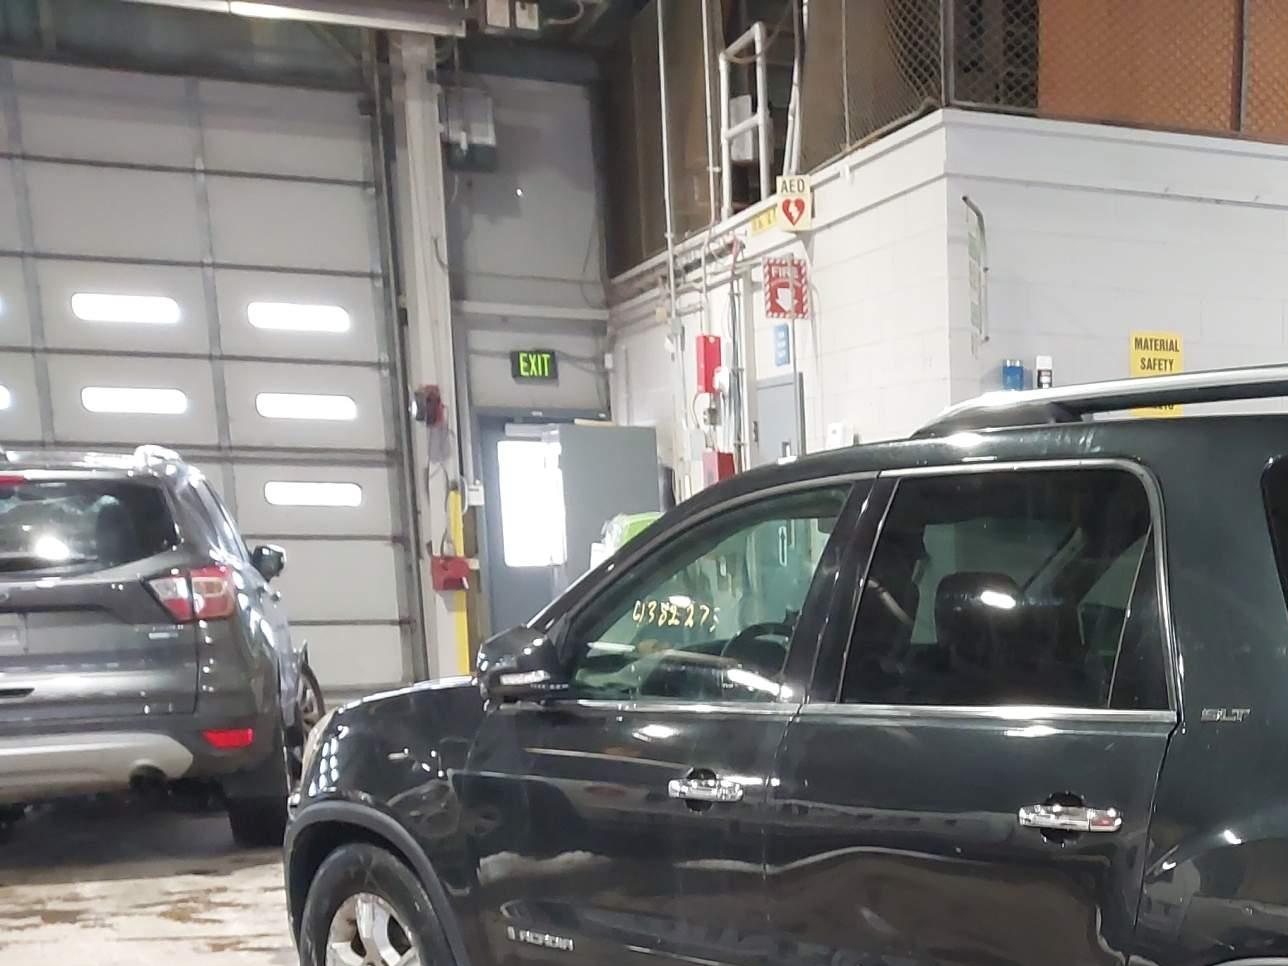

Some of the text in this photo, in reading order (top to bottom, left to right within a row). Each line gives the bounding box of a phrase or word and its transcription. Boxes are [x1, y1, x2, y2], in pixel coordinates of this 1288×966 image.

[780, 177, 806, 194] AED
[1133, 336, 1180, 353] MATERIAL
[519, 352, 551, 377] EXIT
[1139, 357, 1175, 372] SAFETY
